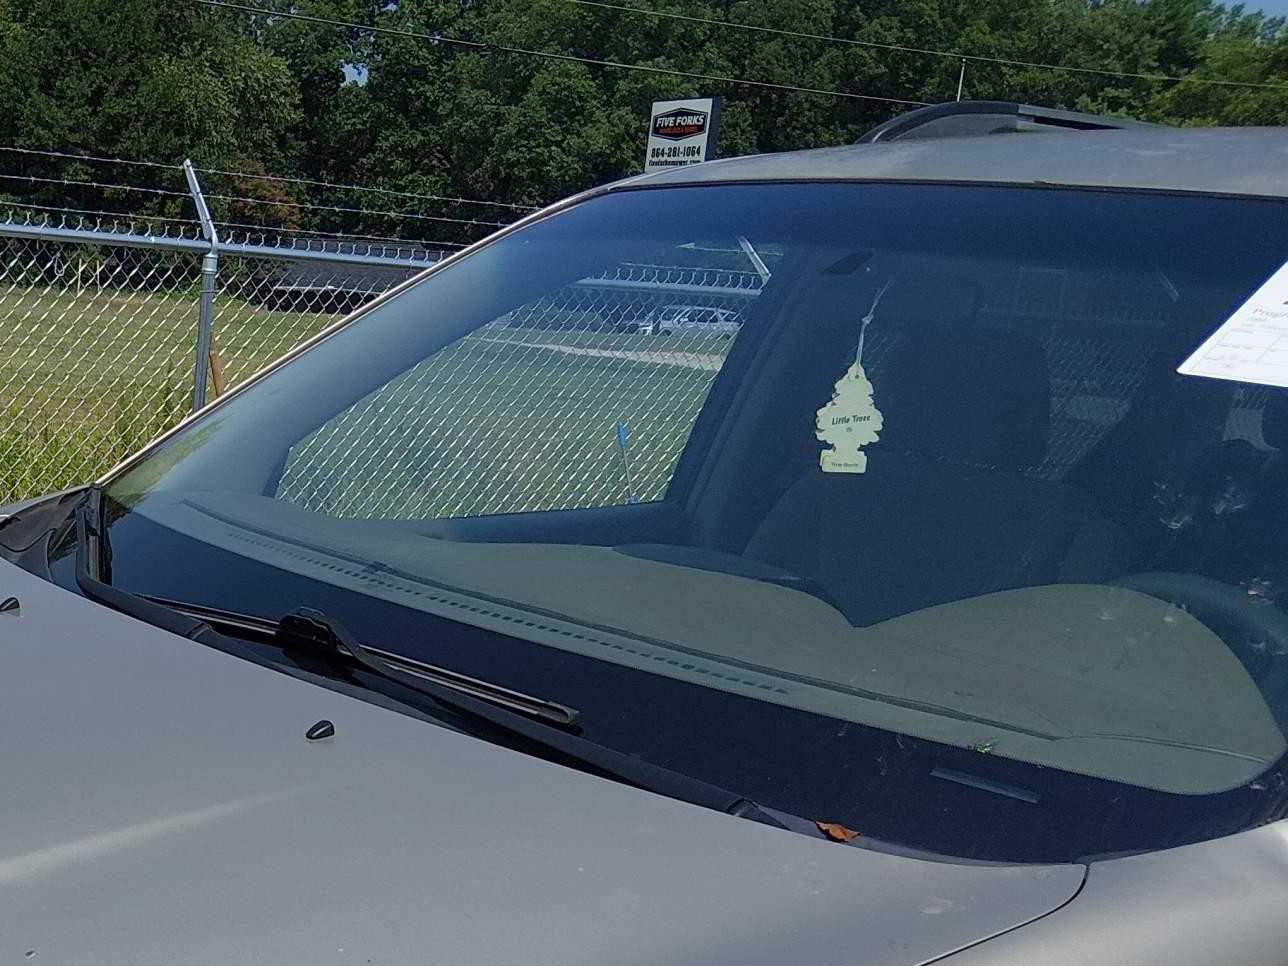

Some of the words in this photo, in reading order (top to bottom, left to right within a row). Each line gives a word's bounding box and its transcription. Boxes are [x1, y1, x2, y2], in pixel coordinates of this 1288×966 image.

[656, 117, 675, 127] FIVE
[676, 115, 704, 125] FORKS
[831, 416, 850, 426] Little
